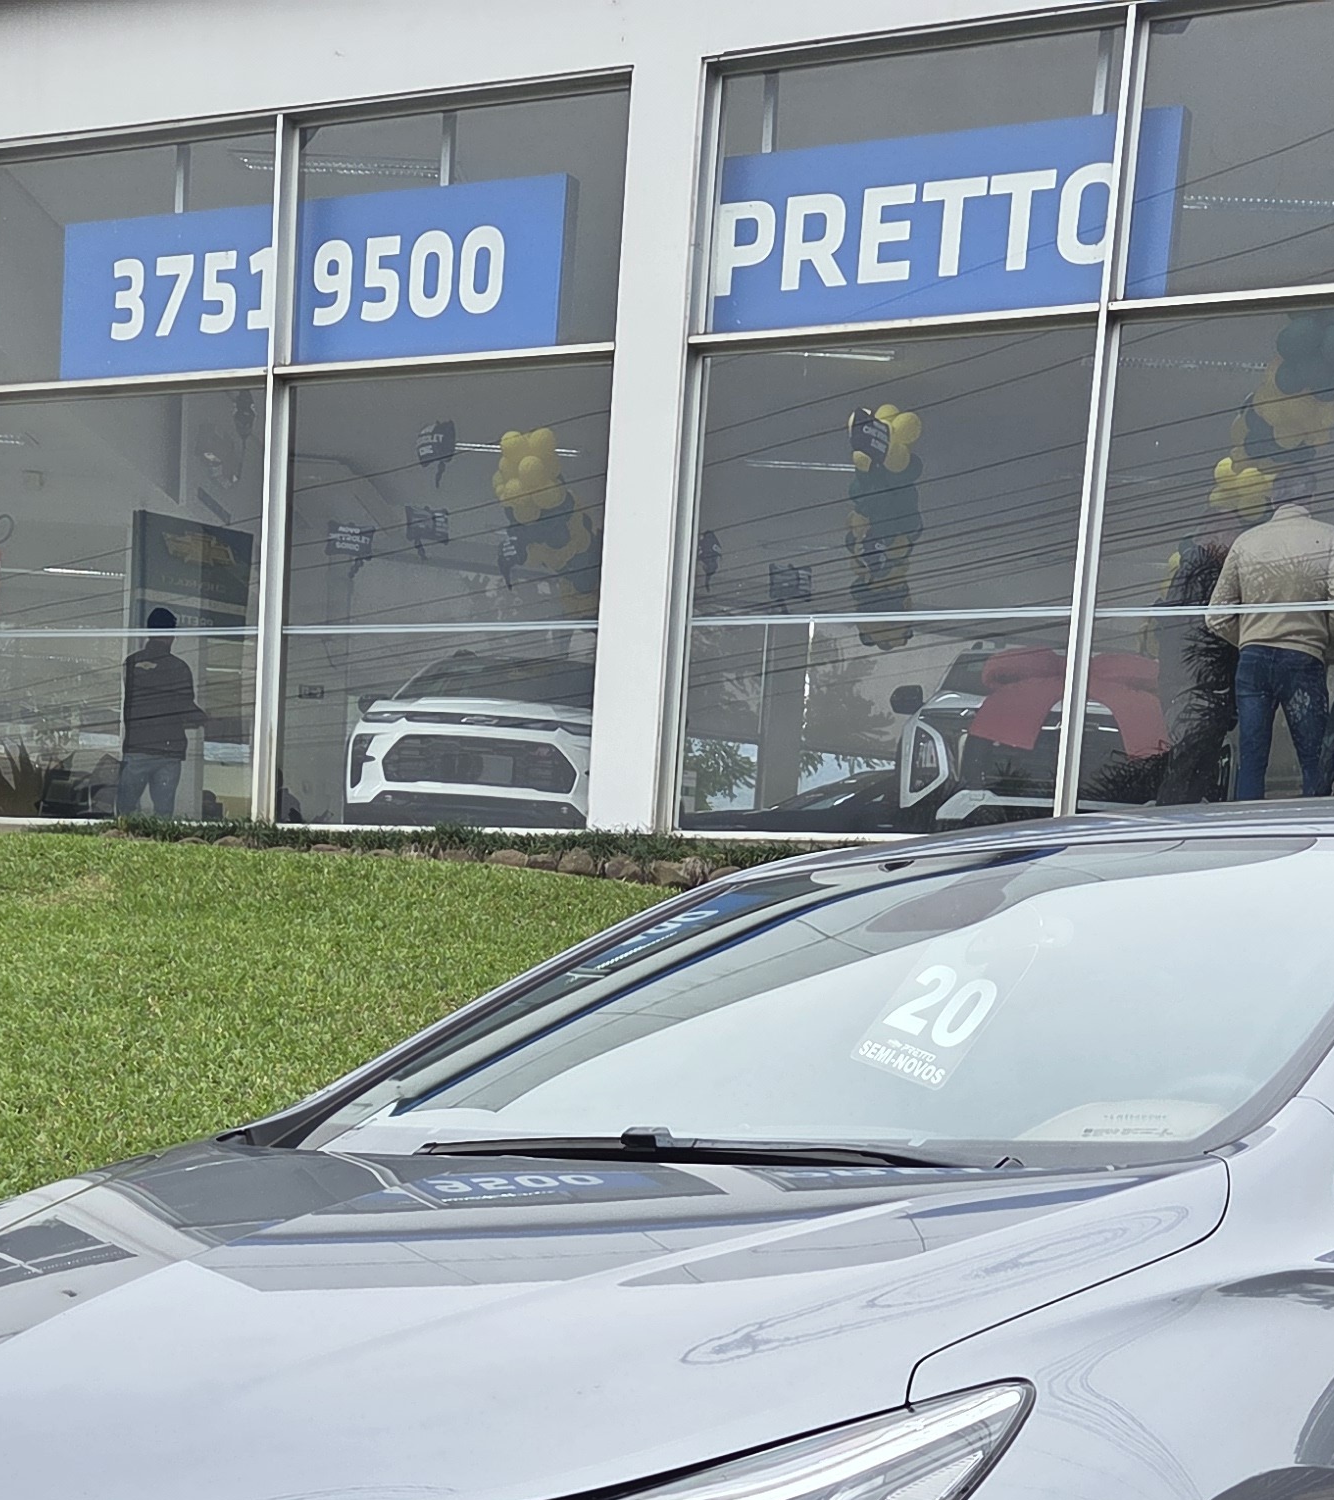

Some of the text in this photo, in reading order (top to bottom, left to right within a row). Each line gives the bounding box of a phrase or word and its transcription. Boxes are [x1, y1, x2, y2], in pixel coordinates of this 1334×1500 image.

[714, 162, 1114, 297] PRETTO
[109, 225, 506, 341] 3751 9500
[882, 964, 998, 1048] 20
[858, 1039, 946, 1084] SEMI-NOVOS
